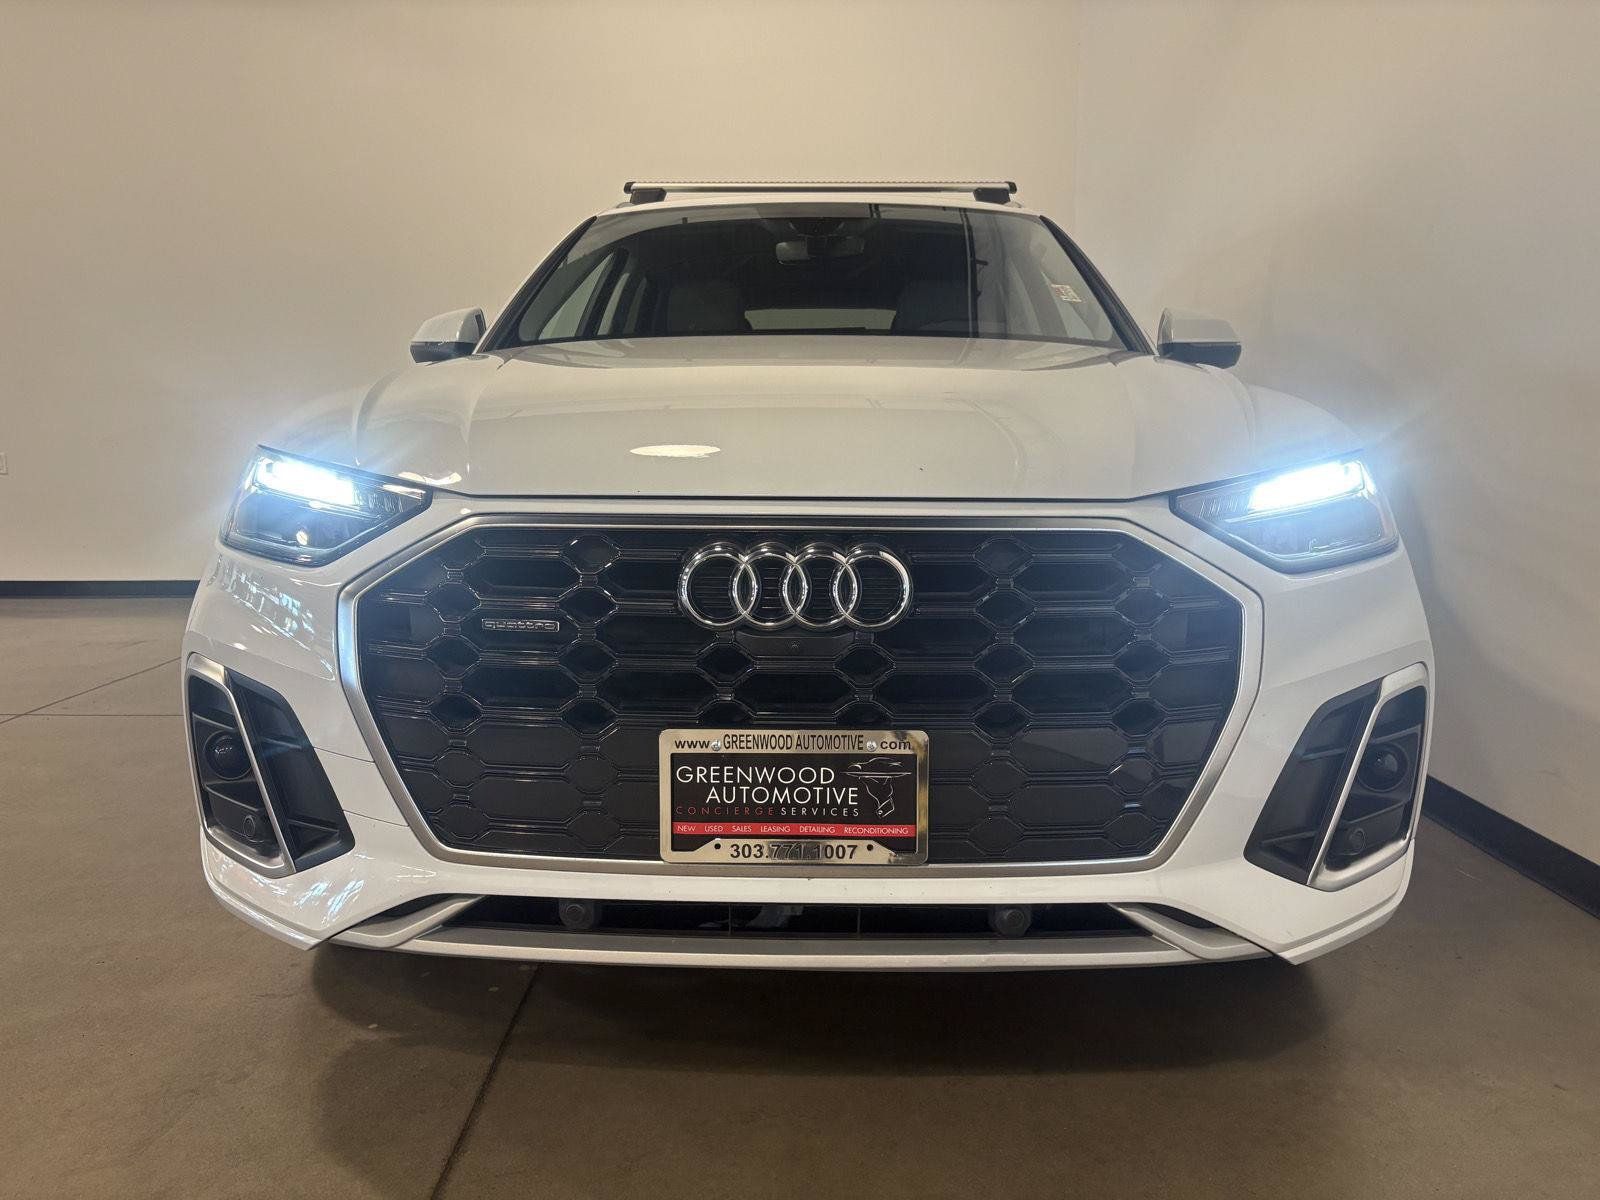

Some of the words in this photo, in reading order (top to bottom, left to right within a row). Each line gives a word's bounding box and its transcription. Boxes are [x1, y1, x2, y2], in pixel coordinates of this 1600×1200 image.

[675, 739, 710, 749] www
[724, 734, 793, 750] GREENWOOD
[795, 735, 864, 750] AUTOMOTIVE
[880, 739, 911, 750] com
[677, 766, 834, 784] GREENWOOD
[706, 787, 858, 805] AUTOMOTIVE
[676, 807, 774, 816] CONCIERGE
[781, 808, 859, 817] SERVICES
[800, 826, 835, 834] DETAILING
